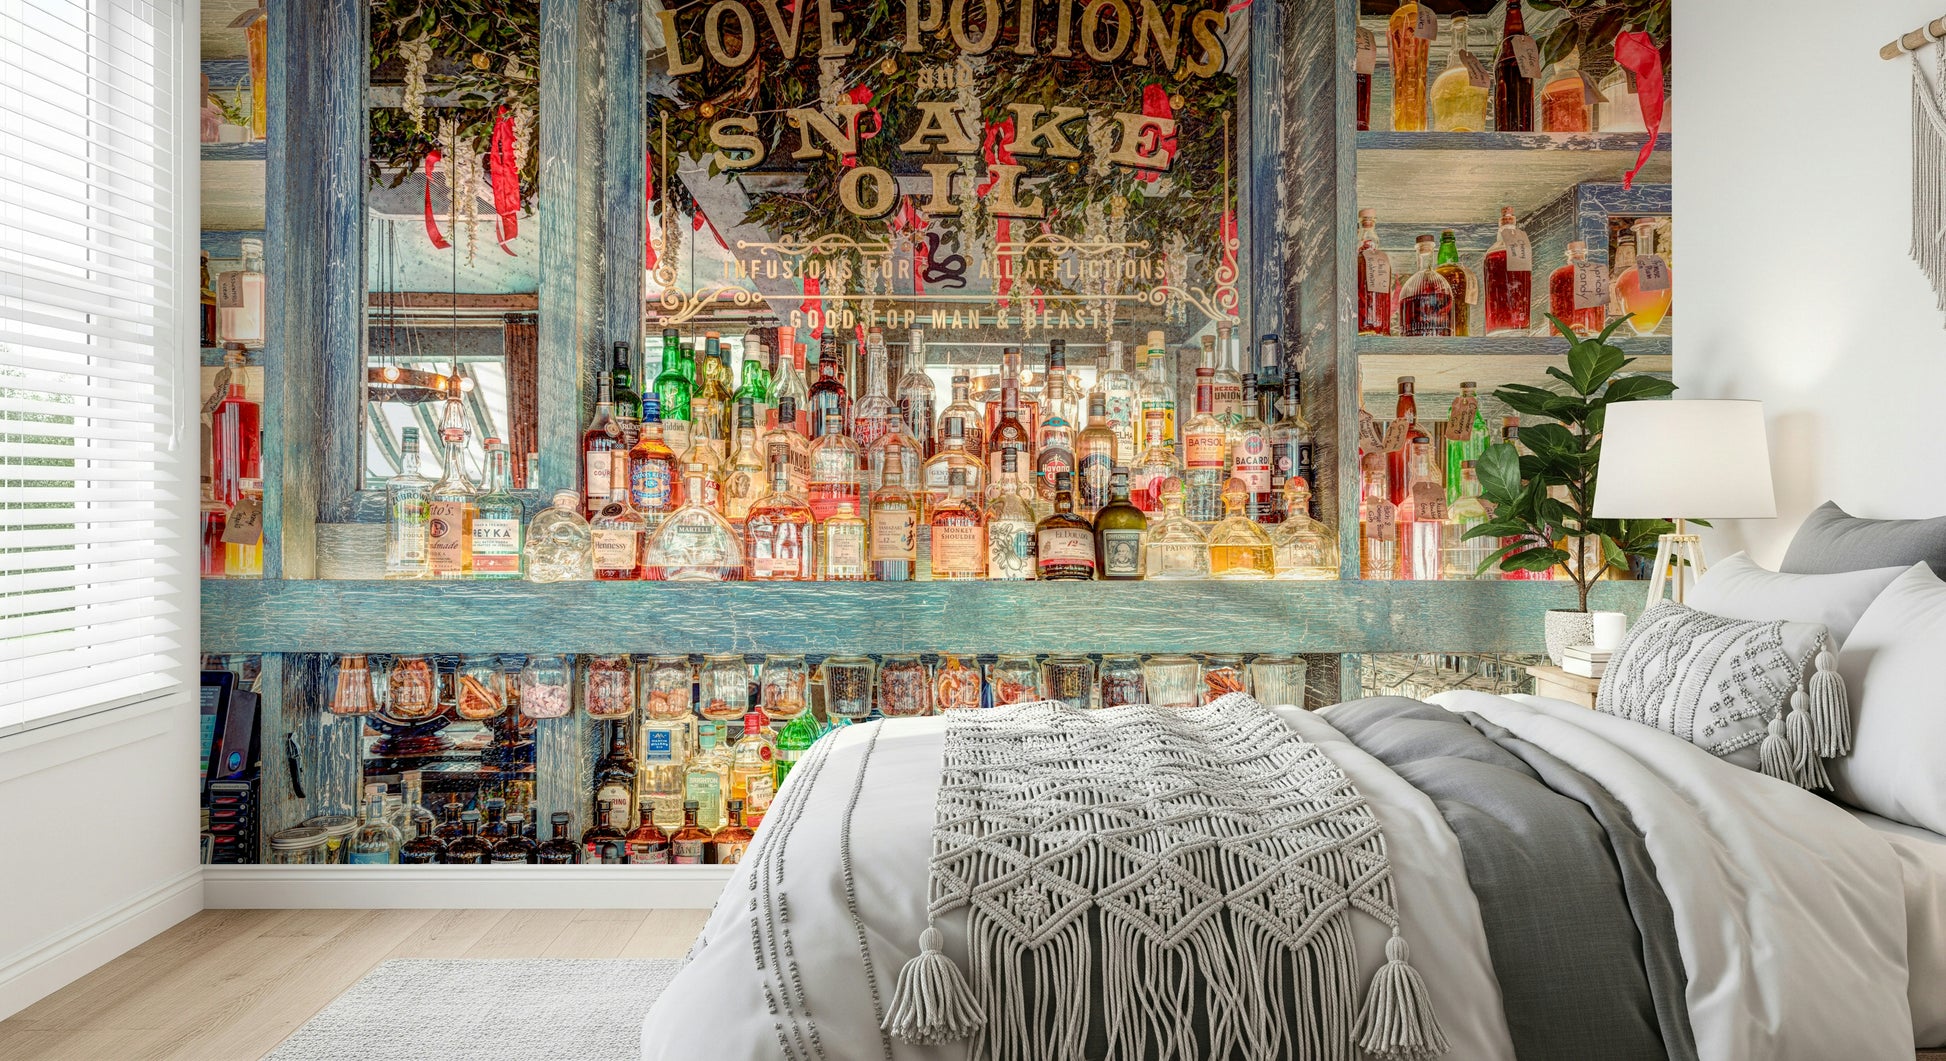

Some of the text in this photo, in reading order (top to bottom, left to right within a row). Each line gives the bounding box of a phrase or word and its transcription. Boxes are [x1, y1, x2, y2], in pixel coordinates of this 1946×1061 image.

[656, 0, 1227, 78] LOVE POTIONS
[917, 59, 976, 89] and
[709, 101, 1176, 171] SNAKE
[839, 164, 1043, 217] OIL
[1517, 240, 1526, 259] Cherry
[723, 259, 1166, 279] INFUSIONS FOR ALL AFFLICTIONS
[1576, 263, 1593, 300] Brandy
[1590, 265, 1605, 298] Apricot
[790, 310, 1101, 329] GOOD FOR MAN & BEAST
[1188, 438, 1223, 447] BARSOL
[1042, 463, 1070, 472] Havana
[595, 541, 627, 550] Hennessy
